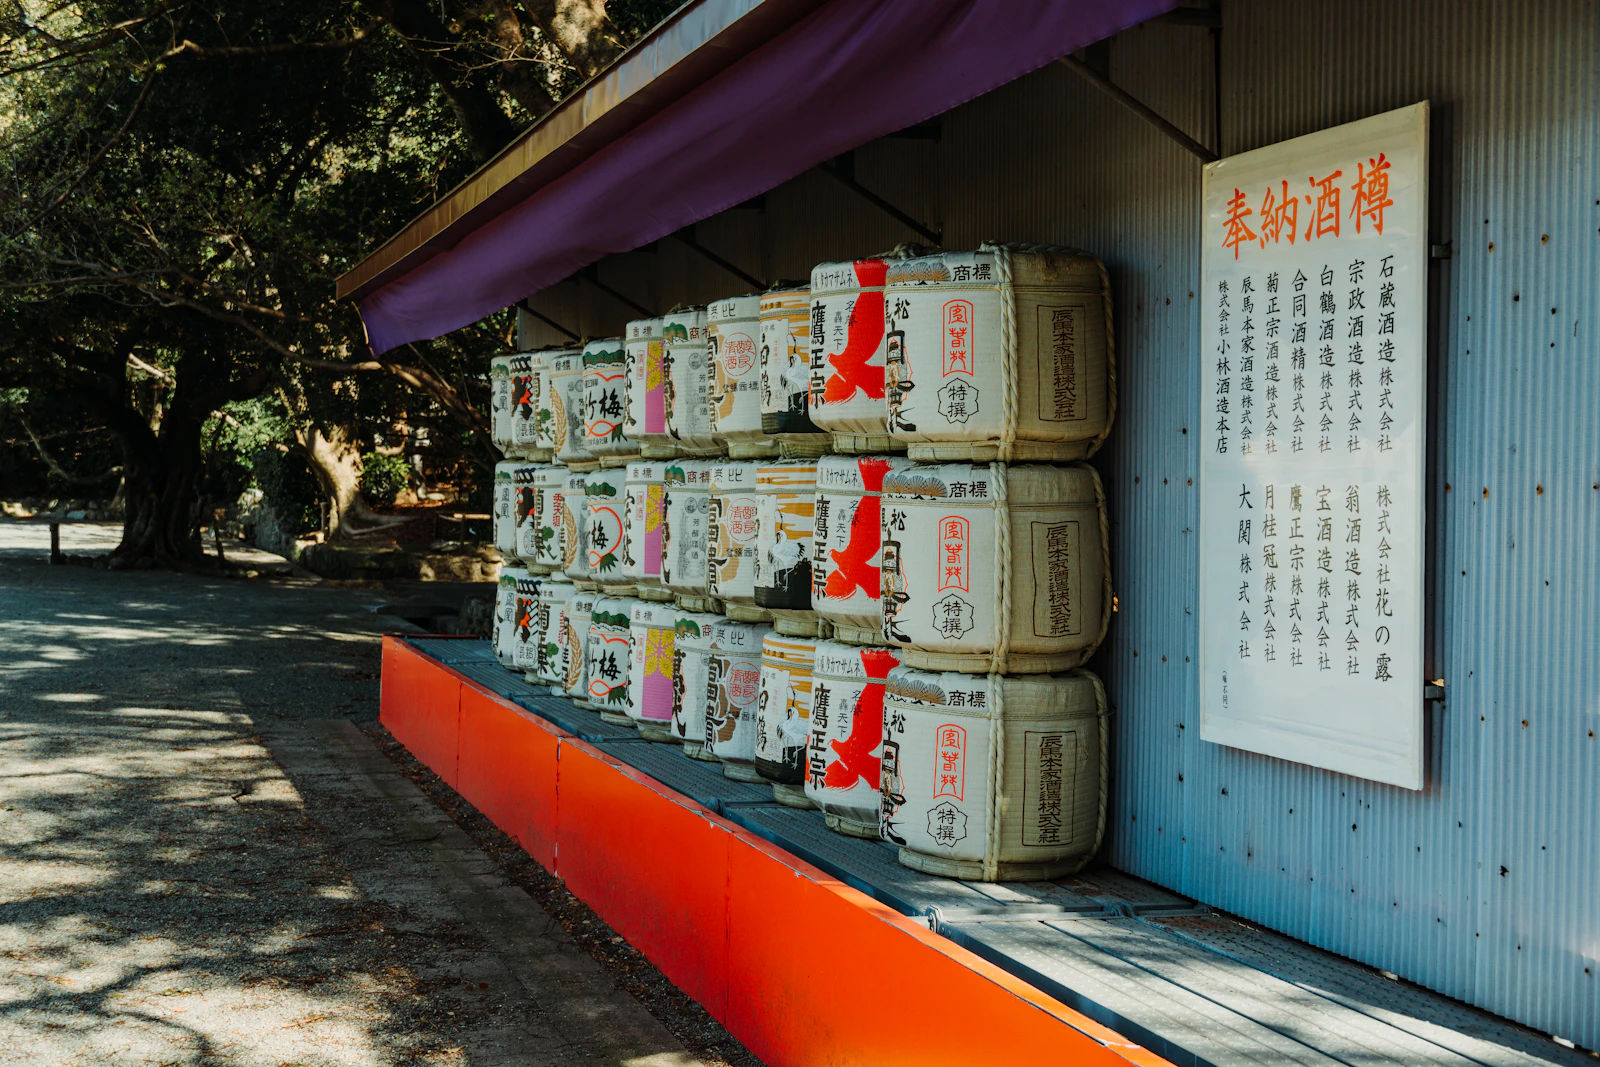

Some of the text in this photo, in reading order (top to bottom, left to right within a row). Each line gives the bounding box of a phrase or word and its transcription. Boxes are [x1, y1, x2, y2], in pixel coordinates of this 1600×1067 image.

[953, 264, 992, 282] 商標
[1221, 152, 1394, 260] 奉納酒樽
[810, 301, 827, 409] 鷹正宗
[947, 384, 968, 418] 特撰
[1051, 309, 1077, 419] 辰馬本家酒造株式会社
[1215, 280, 1231, 454] 株式会社小林酒造本店
[1240, 276, 1256, 456] 辰馬本家酒造株式会社
[1264, 271, 1281, 455] 菊正宗酒造株式会社
[1291, 268, 1308, 453] 合同酒精株式会社
[1318, 264, 1336, 453] 白鶴酒造株式会社
[1347, 259, 1366, 453] 宗政酒造株式会社
[1377, 255, 1396, 453] 石蔵酒造株式会社
[813, 495, 831, 601] 鷹正宗
[949, 481, 988, 498] 商標
[942, 600, 963, 633] 特撰
[1045, 525, 1071, 635] 辰馬本家酒造株式会社
[1237, 483, 1253, 660] 大関株式会社
[1262, 484, 1278, 663] 月桂冠株式会社
[1289, 483, 1305, 667] 鷹正宗株式会社
[1315, 484, 1333, 672] 宝酒造株式会社
[1344, 484, 1362, 676] 翁酒造株式会社
[1374, 485, 1393, 682] 株式会社花の露
[809, 683, 831, 791] 鷹正宗
[948, 690, 986, 708] 商標
[936, 809, 957, 842] 特撰
[1038, 735, 1064, 845] 辰馬本家酒造株式会社
